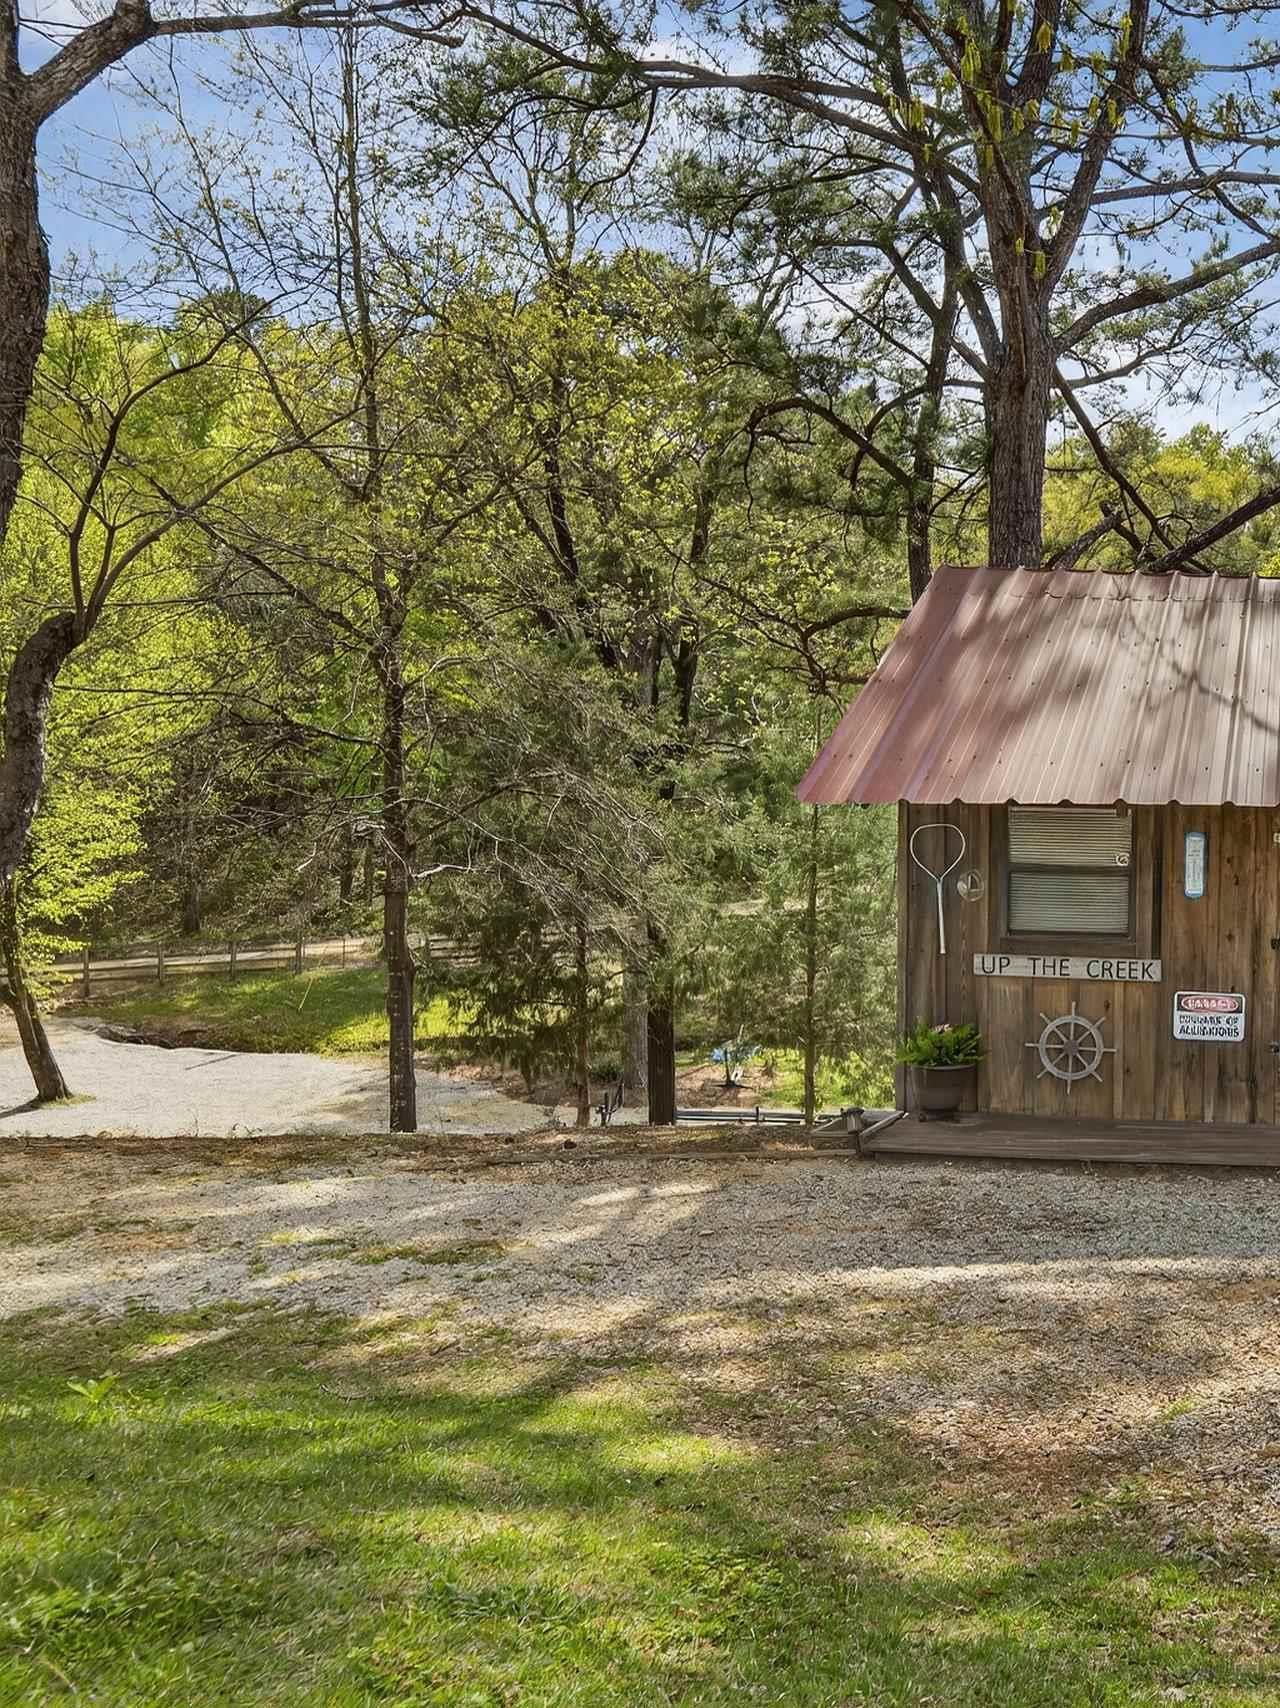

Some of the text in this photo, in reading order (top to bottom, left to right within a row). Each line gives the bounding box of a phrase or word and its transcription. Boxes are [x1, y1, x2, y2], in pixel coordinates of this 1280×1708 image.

[981, 956, 1154, 980] UP THE CREEK
